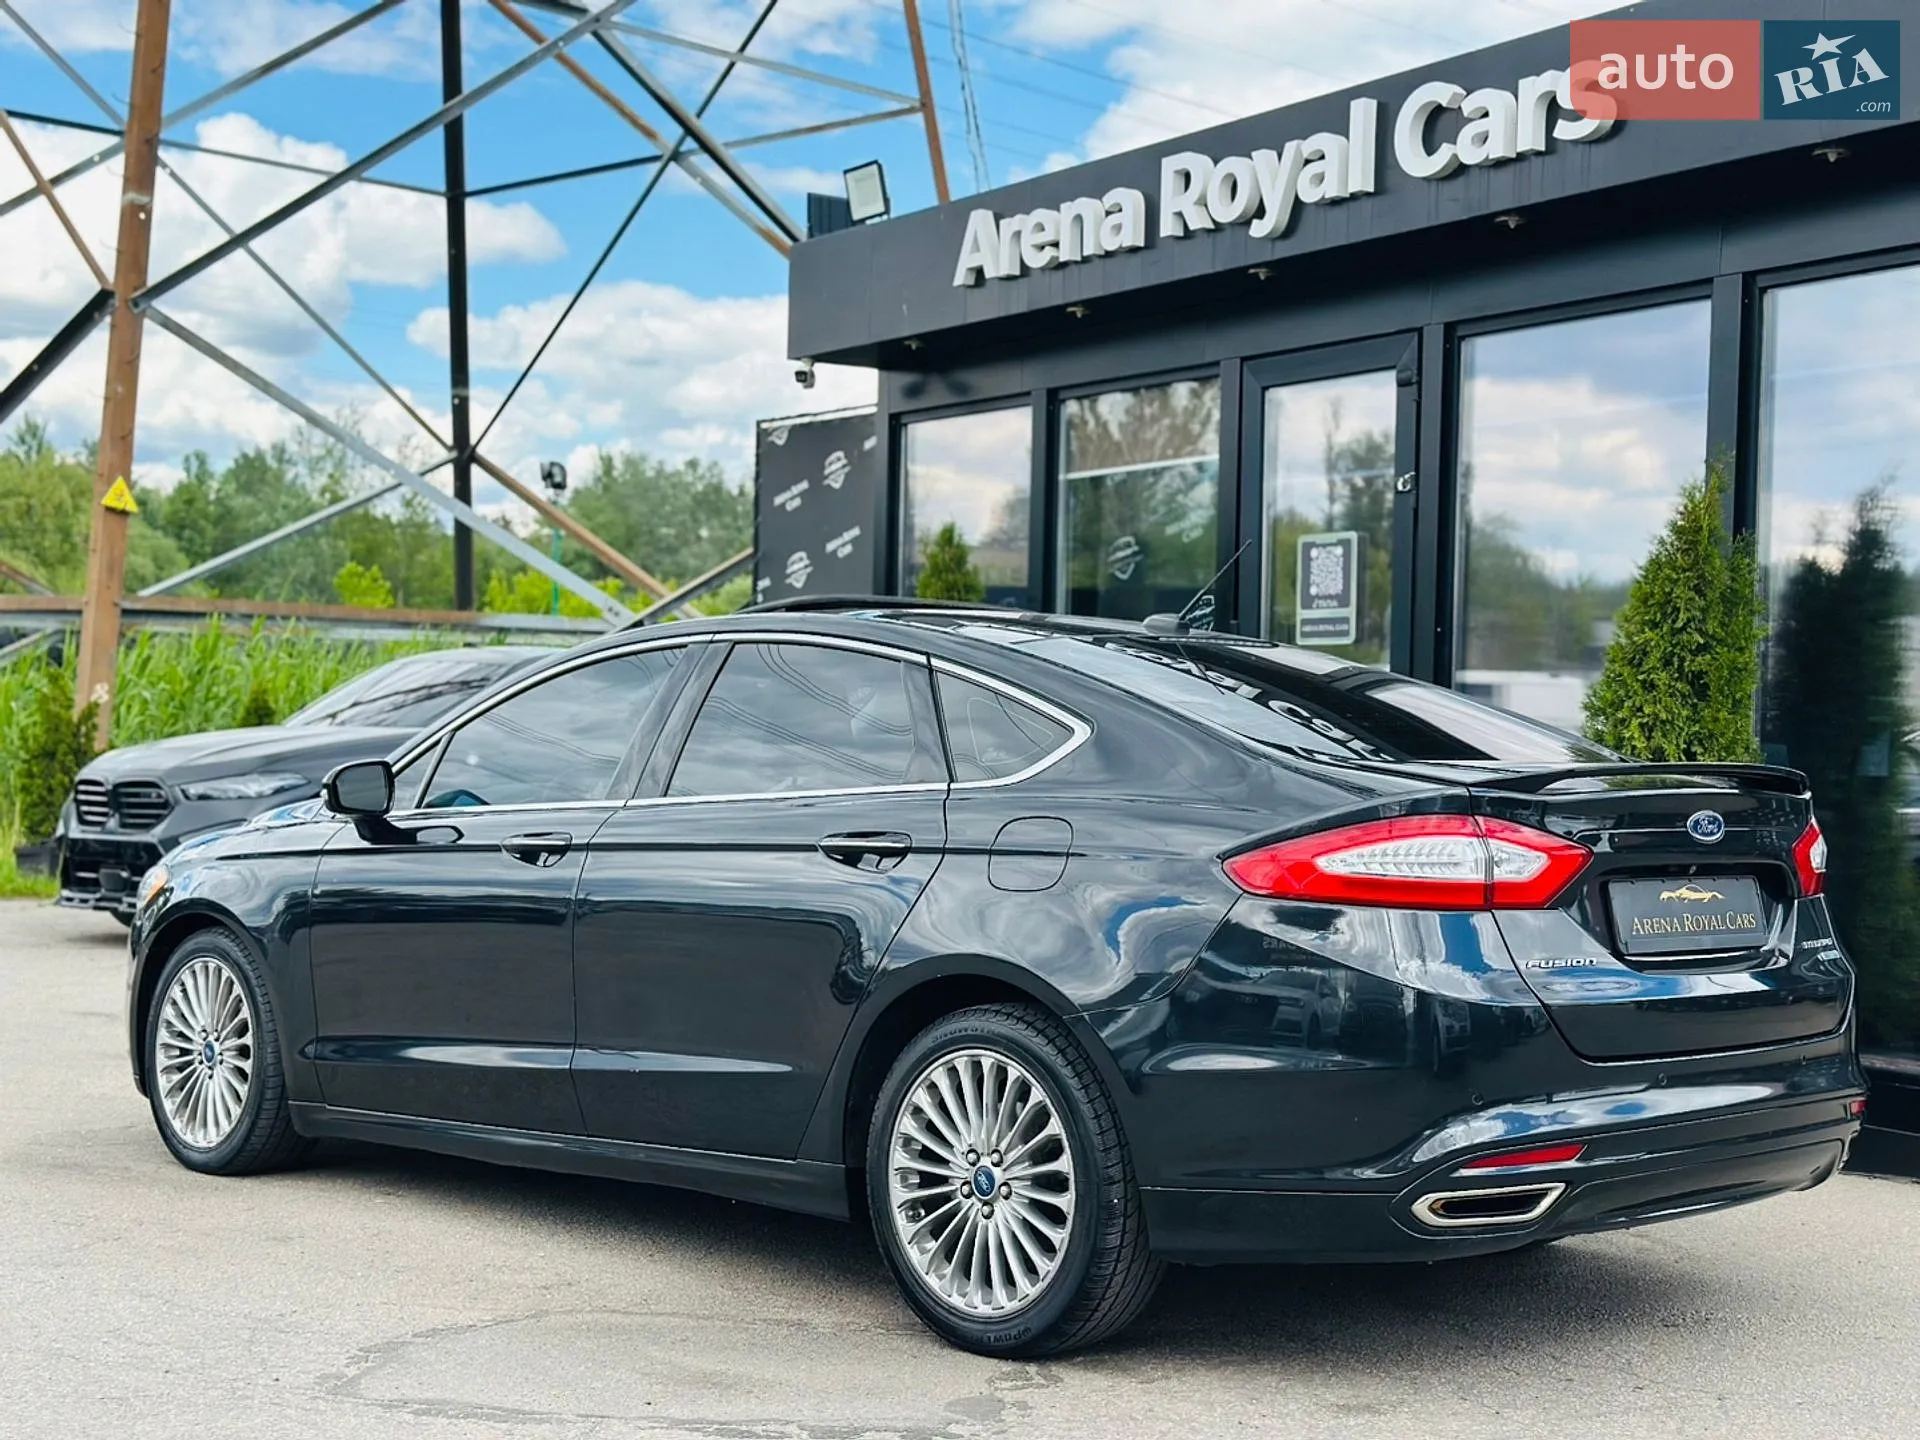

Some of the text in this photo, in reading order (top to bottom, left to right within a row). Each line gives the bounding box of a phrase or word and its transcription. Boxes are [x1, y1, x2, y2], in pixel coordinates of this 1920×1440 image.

[953, 60, 1618, 287] Arena Royal Cars
[1632, 910, 1757, 935] ARENA ROYAL CARS
[1526, 957, 1597, 969] FUSION
